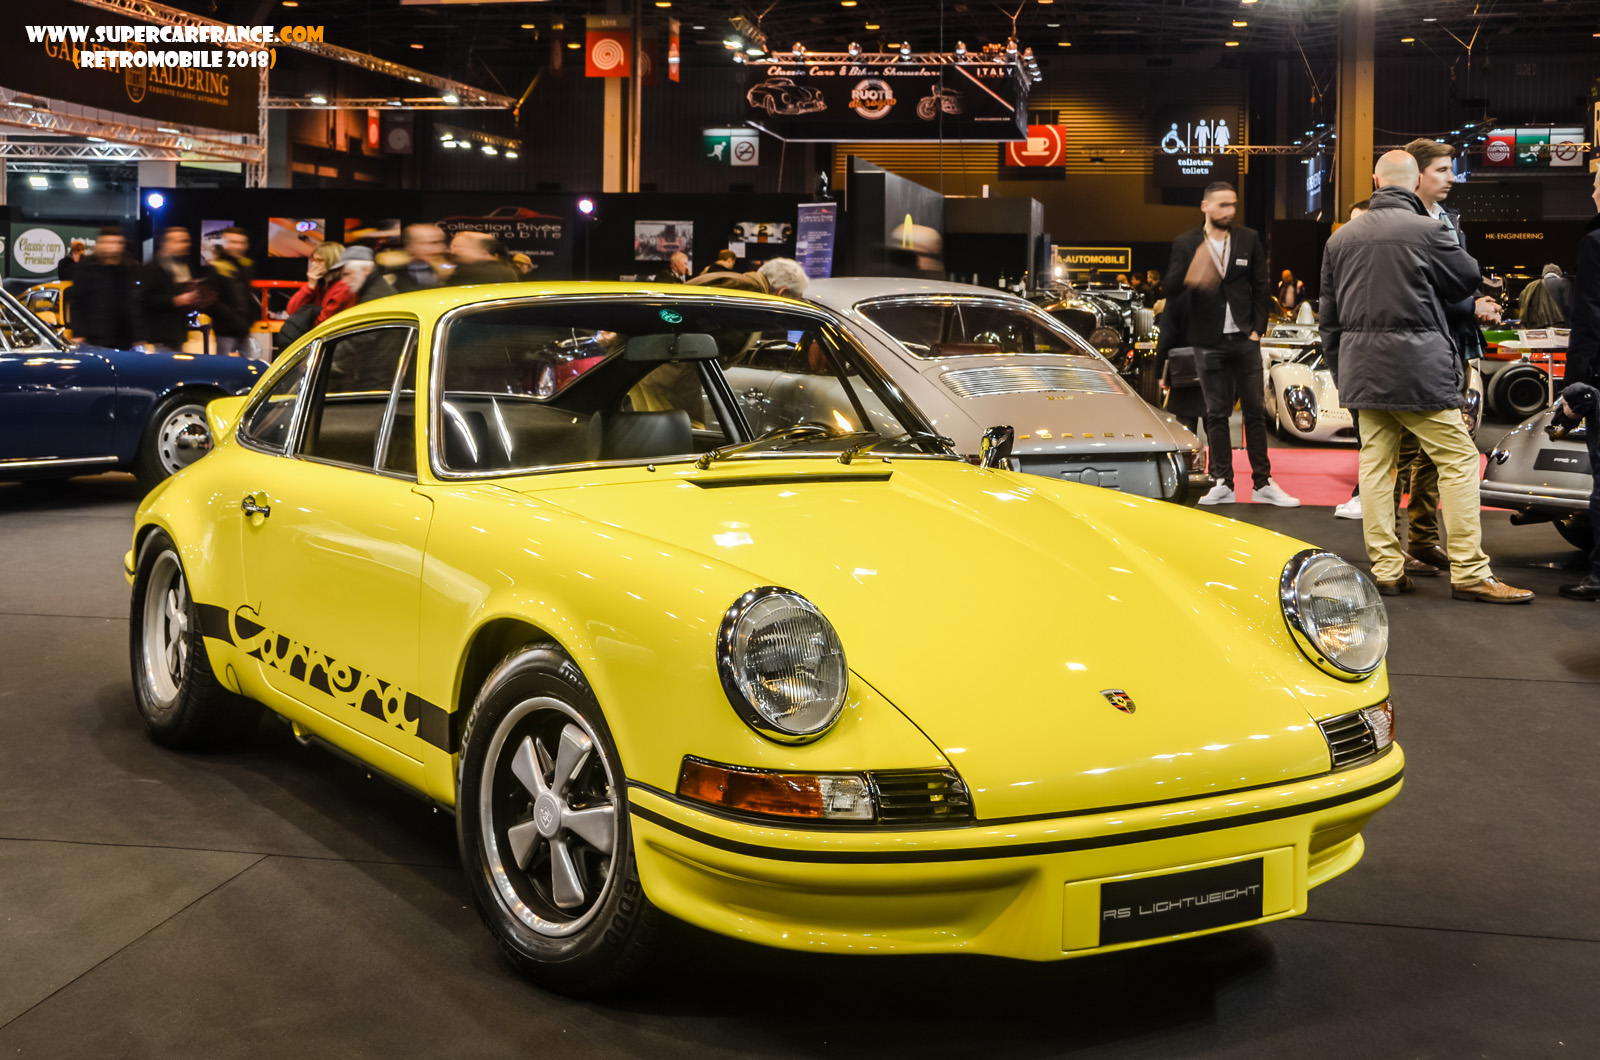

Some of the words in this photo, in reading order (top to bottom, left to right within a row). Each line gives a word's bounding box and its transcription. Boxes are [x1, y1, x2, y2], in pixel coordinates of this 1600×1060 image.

[976, 67, 1013, 76] ITALY
[148, 60, 229, 96] AALDERING
[851, 89, 893, 100] RUOTE
[1177, 158, 1214, 166] toilets
[1182, 167, 1209, 175] toilets
[435, 221, 512, 231] Collection
[516, 222, 562, 232] Privée
[19, 237, 45, 252] Classic
[46, 243, 62, 253] cars
[24, 252, 55, 265] Friesland
[226, 600, 420, 737] Carrera
[1103, 907, 1131, 921] RS
[1139, 884, 1260, 916] LIGHTWEIGHT
